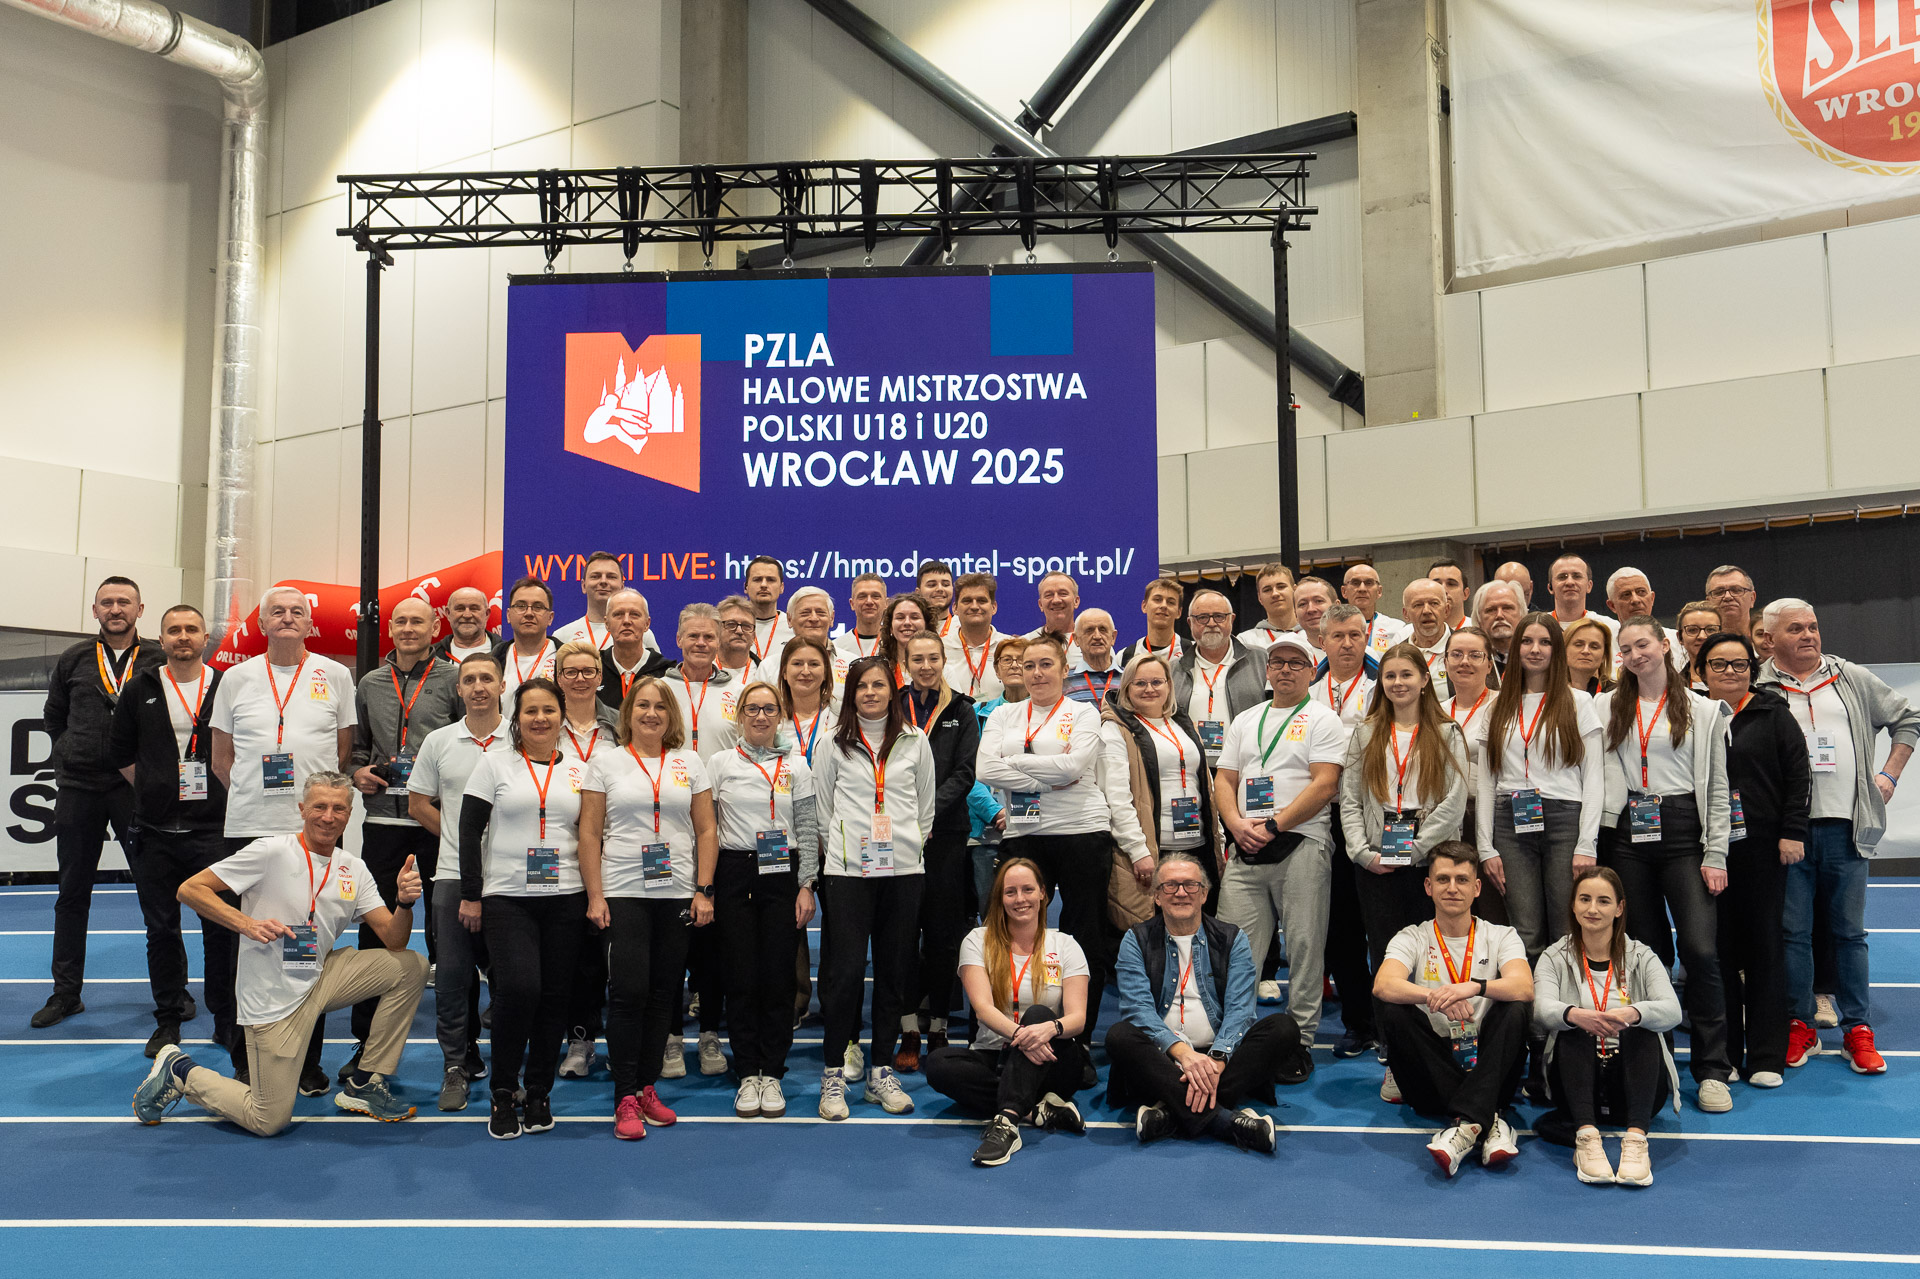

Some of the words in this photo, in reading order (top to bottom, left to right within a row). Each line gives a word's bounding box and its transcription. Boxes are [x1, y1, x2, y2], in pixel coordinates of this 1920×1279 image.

[1814, 82, 1920, 122] WRO
[745, 332, 835, 368] PZLA
[743, 375, 870, 405] HALOWE
[879, 372, 1088, 403] MISTRZOSTWA
[743, 414, 843, 443] POLSKI
[854, 412, 907, 441] U18
[916, 411, 923, 440] i
[934, 411, 989, 440] U20
[742, 449, 959, 488] WROCŁAW
[970, 447, 1064, 485] 2025
[525, 553, 634, 582] WYNKI
[643, 552, 716, 581] LIVE:
[725, 547, 1135, 584] hts://hmp.domtel-sport.pl/
